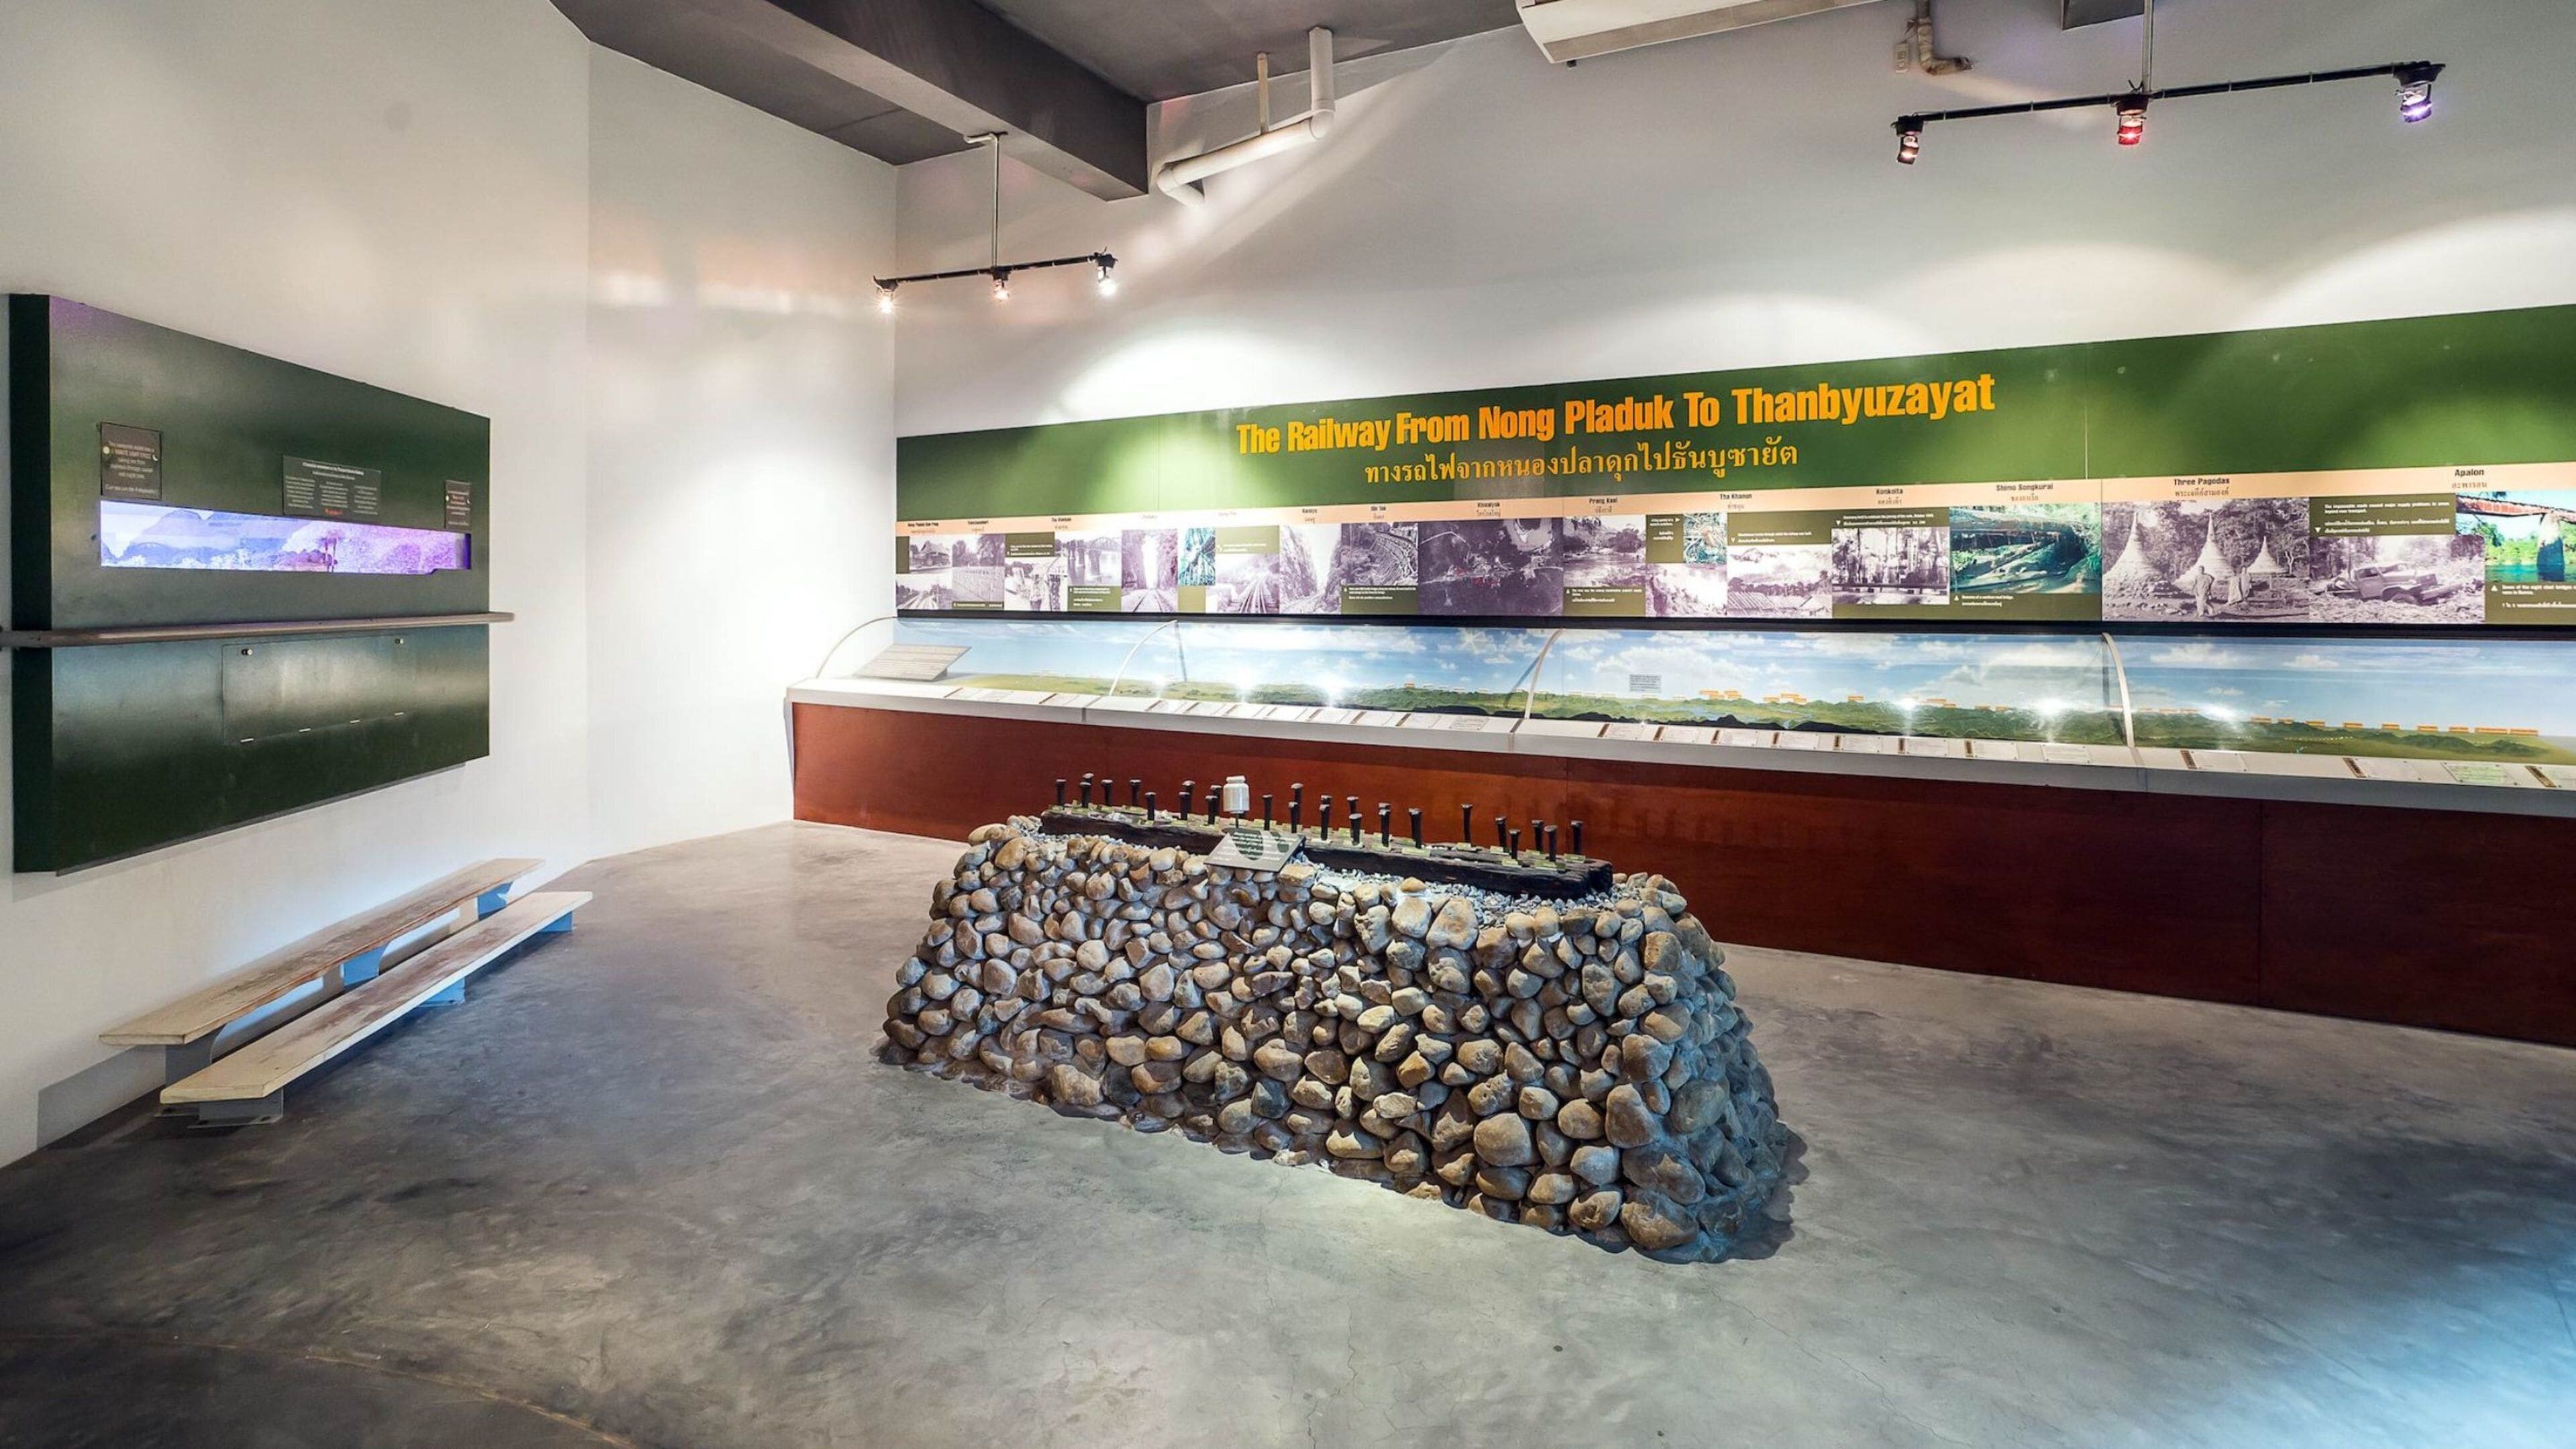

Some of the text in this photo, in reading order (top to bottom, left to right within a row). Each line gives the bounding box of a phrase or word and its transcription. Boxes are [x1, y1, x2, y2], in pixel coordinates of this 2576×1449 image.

[1237, 374, 1996, 454] The Railway From Nong Pladuk To Thanbyuzayat
[1365, 435, 1798, 483] ทางรถไฟจากหนองปลาดุกไปธันบูซายัต
[2198, 478, 2230, 486] Pagodas
[2455, 469, 2484, 478] Apalon
